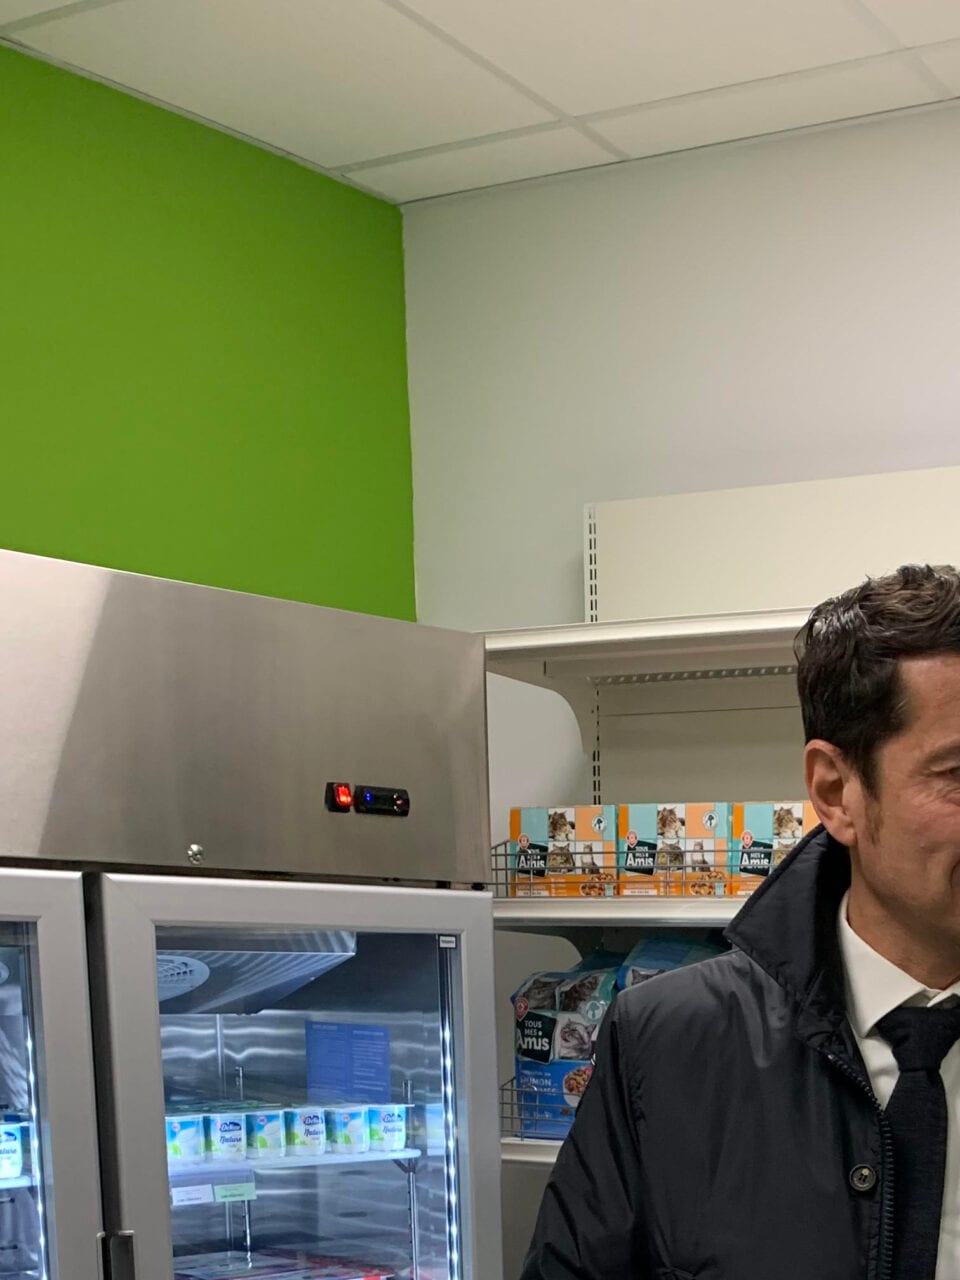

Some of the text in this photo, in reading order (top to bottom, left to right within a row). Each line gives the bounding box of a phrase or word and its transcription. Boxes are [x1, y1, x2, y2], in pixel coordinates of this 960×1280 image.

[627, 852, 654, 867] Amis
[524, 1020, 542, 1028] TOUS
[524, 1028, 537, 1036] MES
[516, 1028, 550, 1051] Amis
